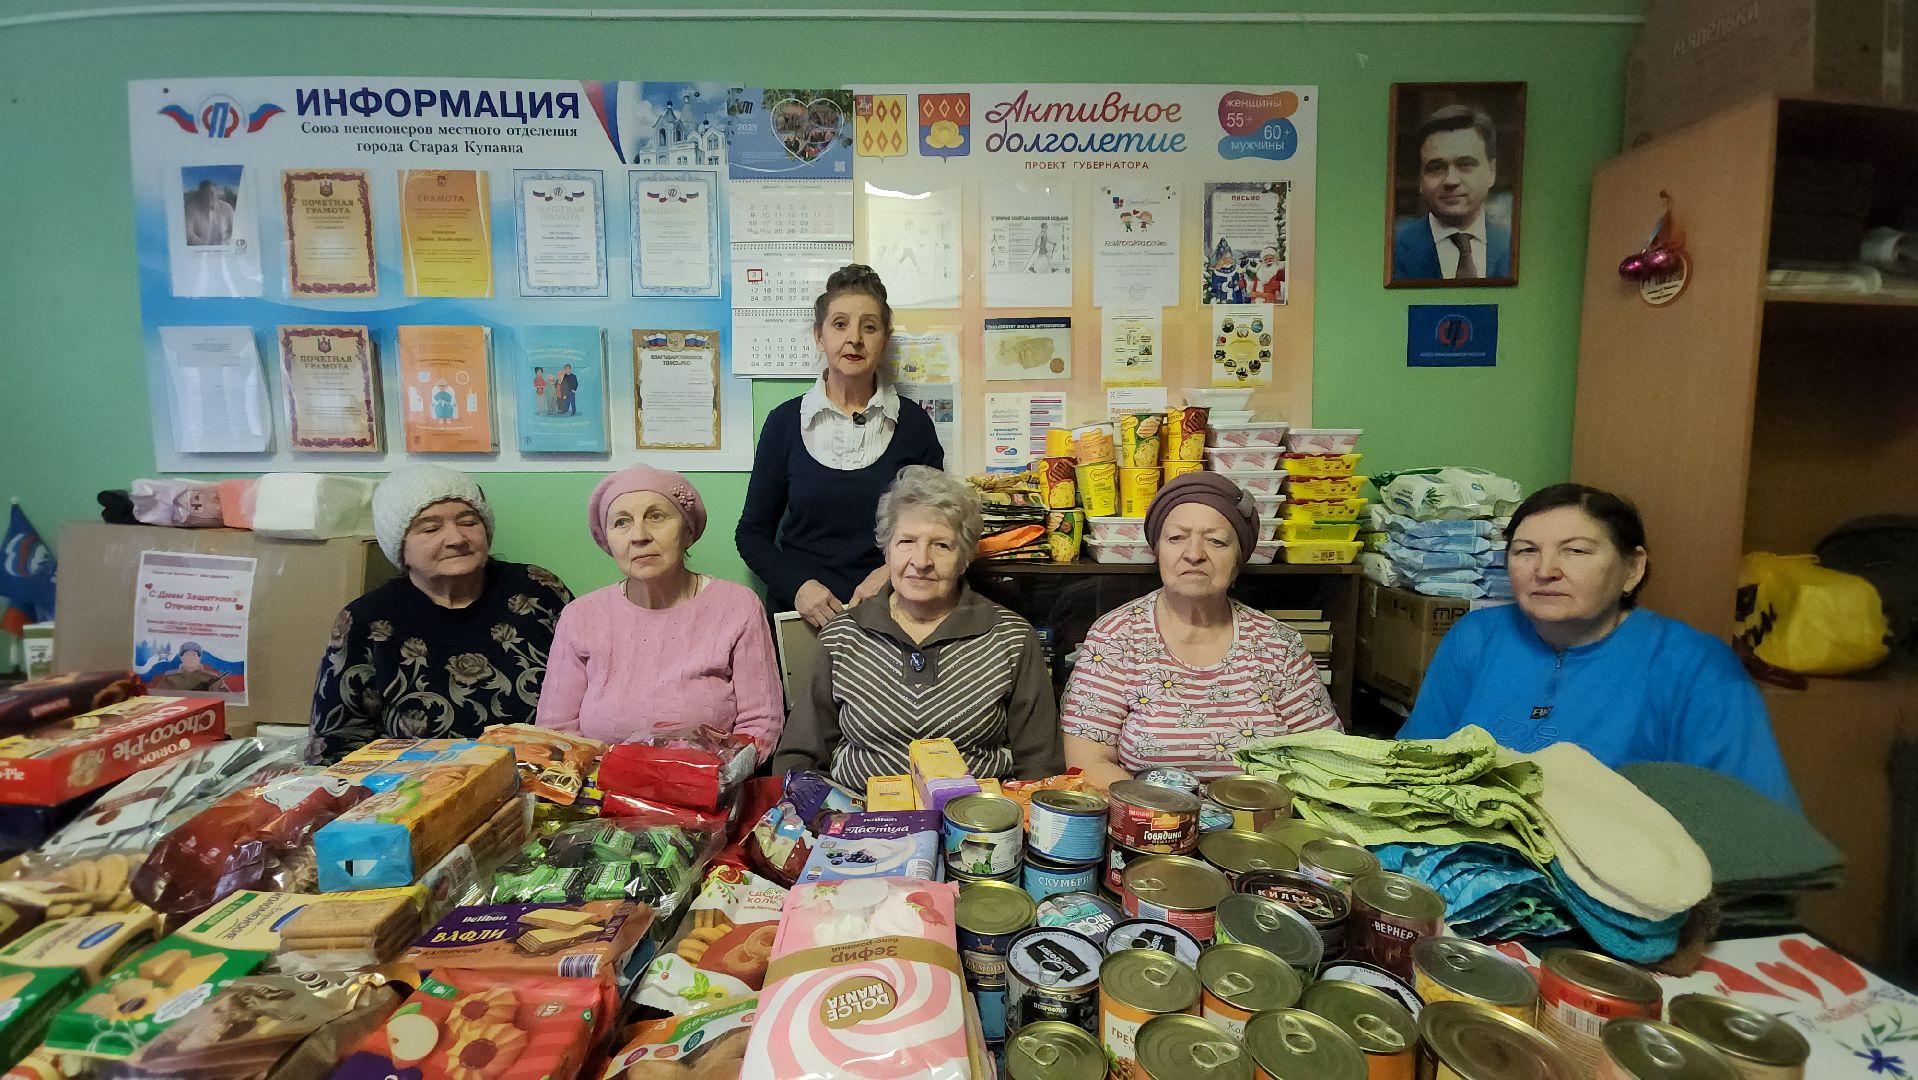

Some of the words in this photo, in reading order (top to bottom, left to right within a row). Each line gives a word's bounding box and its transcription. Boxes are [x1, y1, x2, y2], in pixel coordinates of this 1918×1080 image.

[296, 87, 579, 124] ИНФОРМАЦИЯ
[985, 89, 1182, 123] Активное
[1226, 99, 1281, 109] женщины
[1226, 112, 1253, 128] 55+
[301, 121, 339, 134] Союз
[345, 123, 433, 137] пенсионеров
[438, 125, 501, 137] местного
[506, 125, 578, 138] отделения
[985, 119, 1188, 152] долголетие
[1264, 124, 1290, 140] 60+
[356, 141, 403, 155] города
[409, 139, 458, 156] Старая
[465, 141, 523, 156] Купавна
[1231, 140, 1284, 151] мужчины
[1024, 160, 1065, 170] ПРОЕКТ
[1072, 160, 1150, 170] ГУБЕРНАТОРА
[302, 199, 354, 207] ПОЧЕТНАЯ
[300, 355, 352, 363] ПОЧЕТНАЯ
[186, 592, 238, 603] Защитника
[164, 601, 213, 611] Отечества
[138, 745, 178, 765] ORION
[1143, 830, 1182, 841] Говядина
[430, 928, 508, 943] ВАФЛИ
[1374, 921, 1414, 940] ВЕРНЕР
[831, 945, 898, 963] Зефир
[827, 982, 884, 1010] MANIA
[827, 993, 890, 1022] DOLCE
